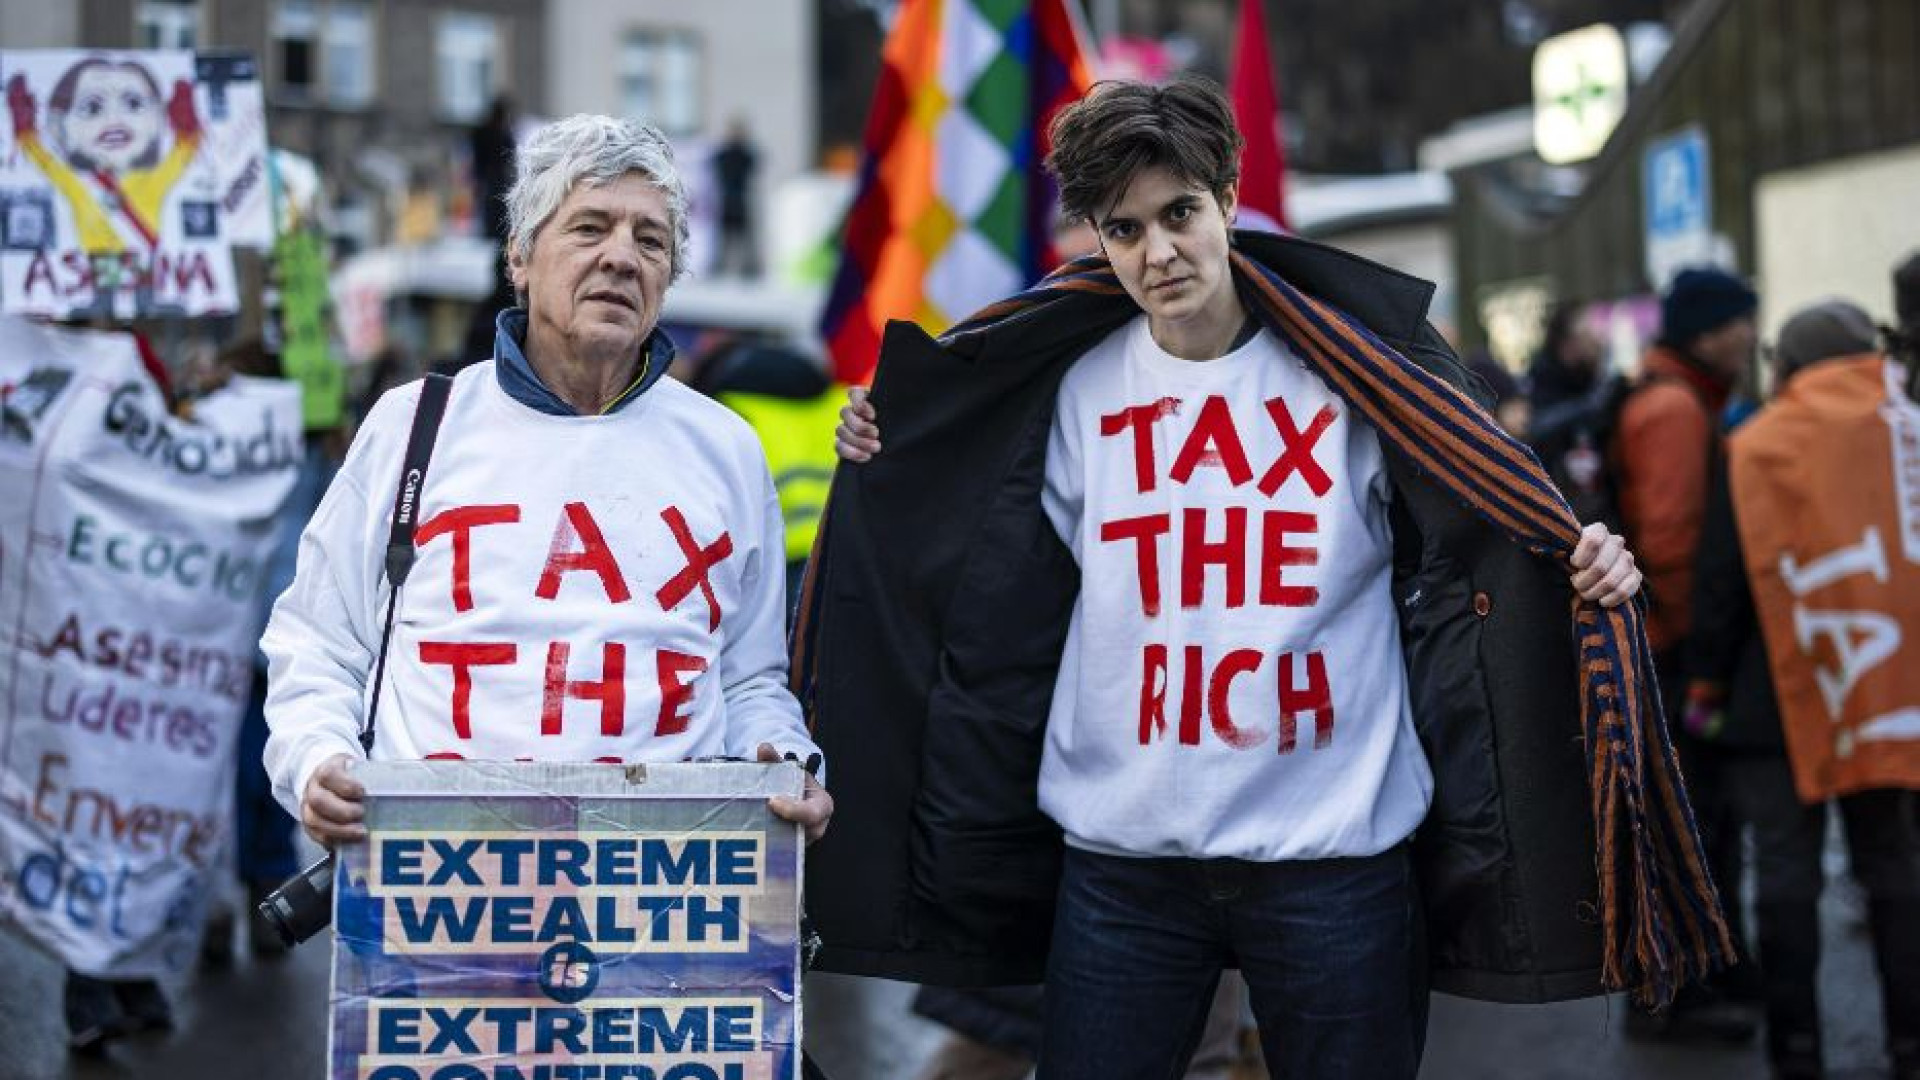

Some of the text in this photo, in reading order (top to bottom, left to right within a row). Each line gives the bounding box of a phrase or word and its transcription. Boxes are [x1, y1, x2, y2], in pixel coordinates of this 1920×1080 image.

[1100, 394, 1339, 498] TAX
[399, 468, 420, 523] Canon
[413, 502, 733, 633] TAX
[1100, 507, 1320, 618] THE
[418, 641, 708, 739] THE
[1137, 644, 1334, 755] RICH
[380, 838, 758, 887] EXTREME
[395, 896, 741, 943] WEALTH
[550, 952, 590, 988] is
[378, 1005, 755, 1054] EXTREME
